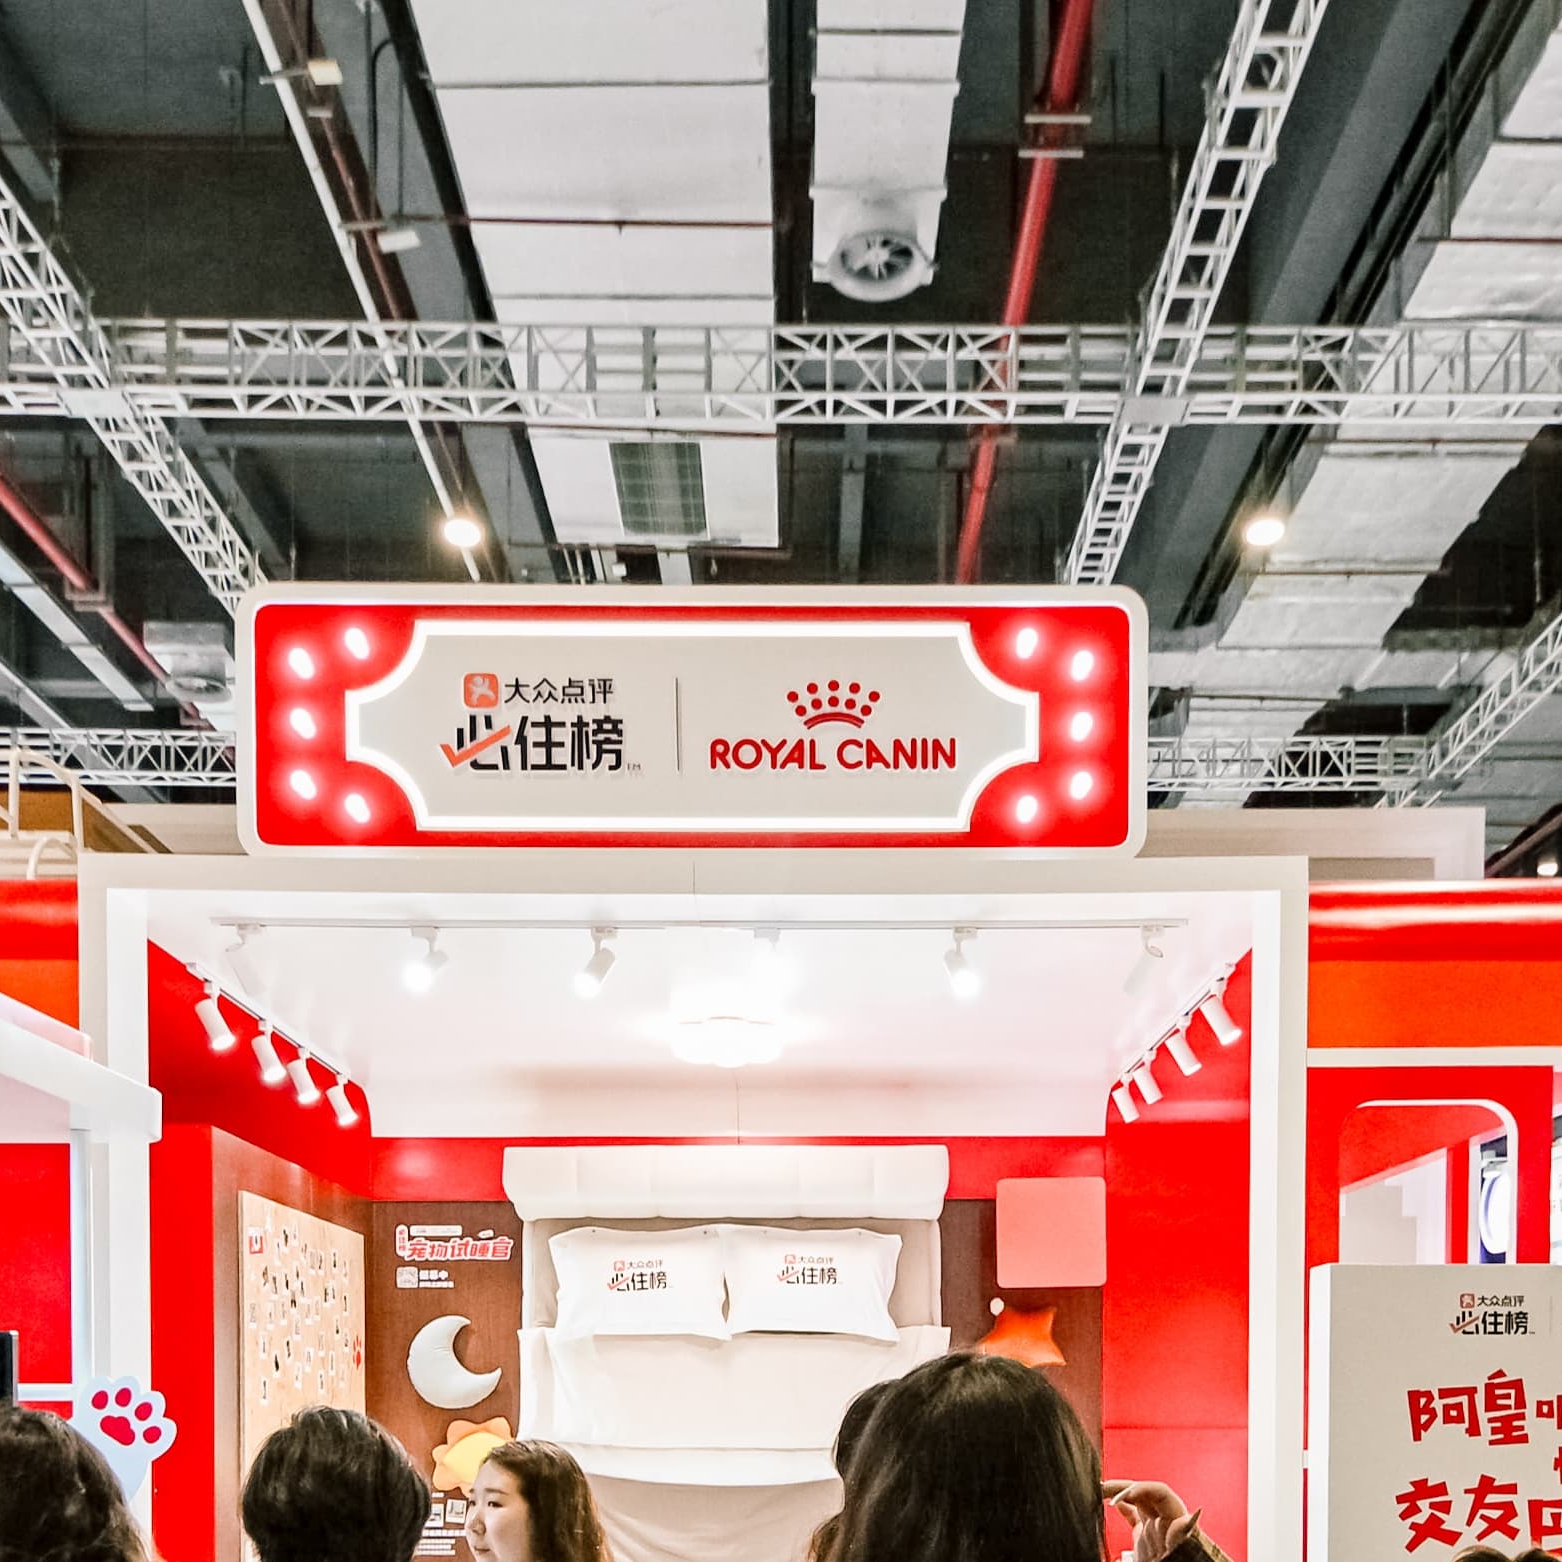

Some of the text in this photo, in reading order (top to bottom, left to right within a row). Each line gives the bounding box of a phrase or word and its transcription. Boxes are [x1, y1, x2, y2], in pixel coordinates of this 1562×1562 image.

[504, 677, 614, 704] 大众点评
[440, 714, 624, 771] 必住榜
[710, 738, 957, 771] ROYAL CANIN
[407, 1239, 512, 1259] 宠物试睡官
[607, 1271, 668, 1292] 必住榜
[776, 1265, 838, 1285] 必住榜
[1477, 1295, 1525, 1308] 大众点评
[1449, 1311, 1529, 1335] 必住榜
